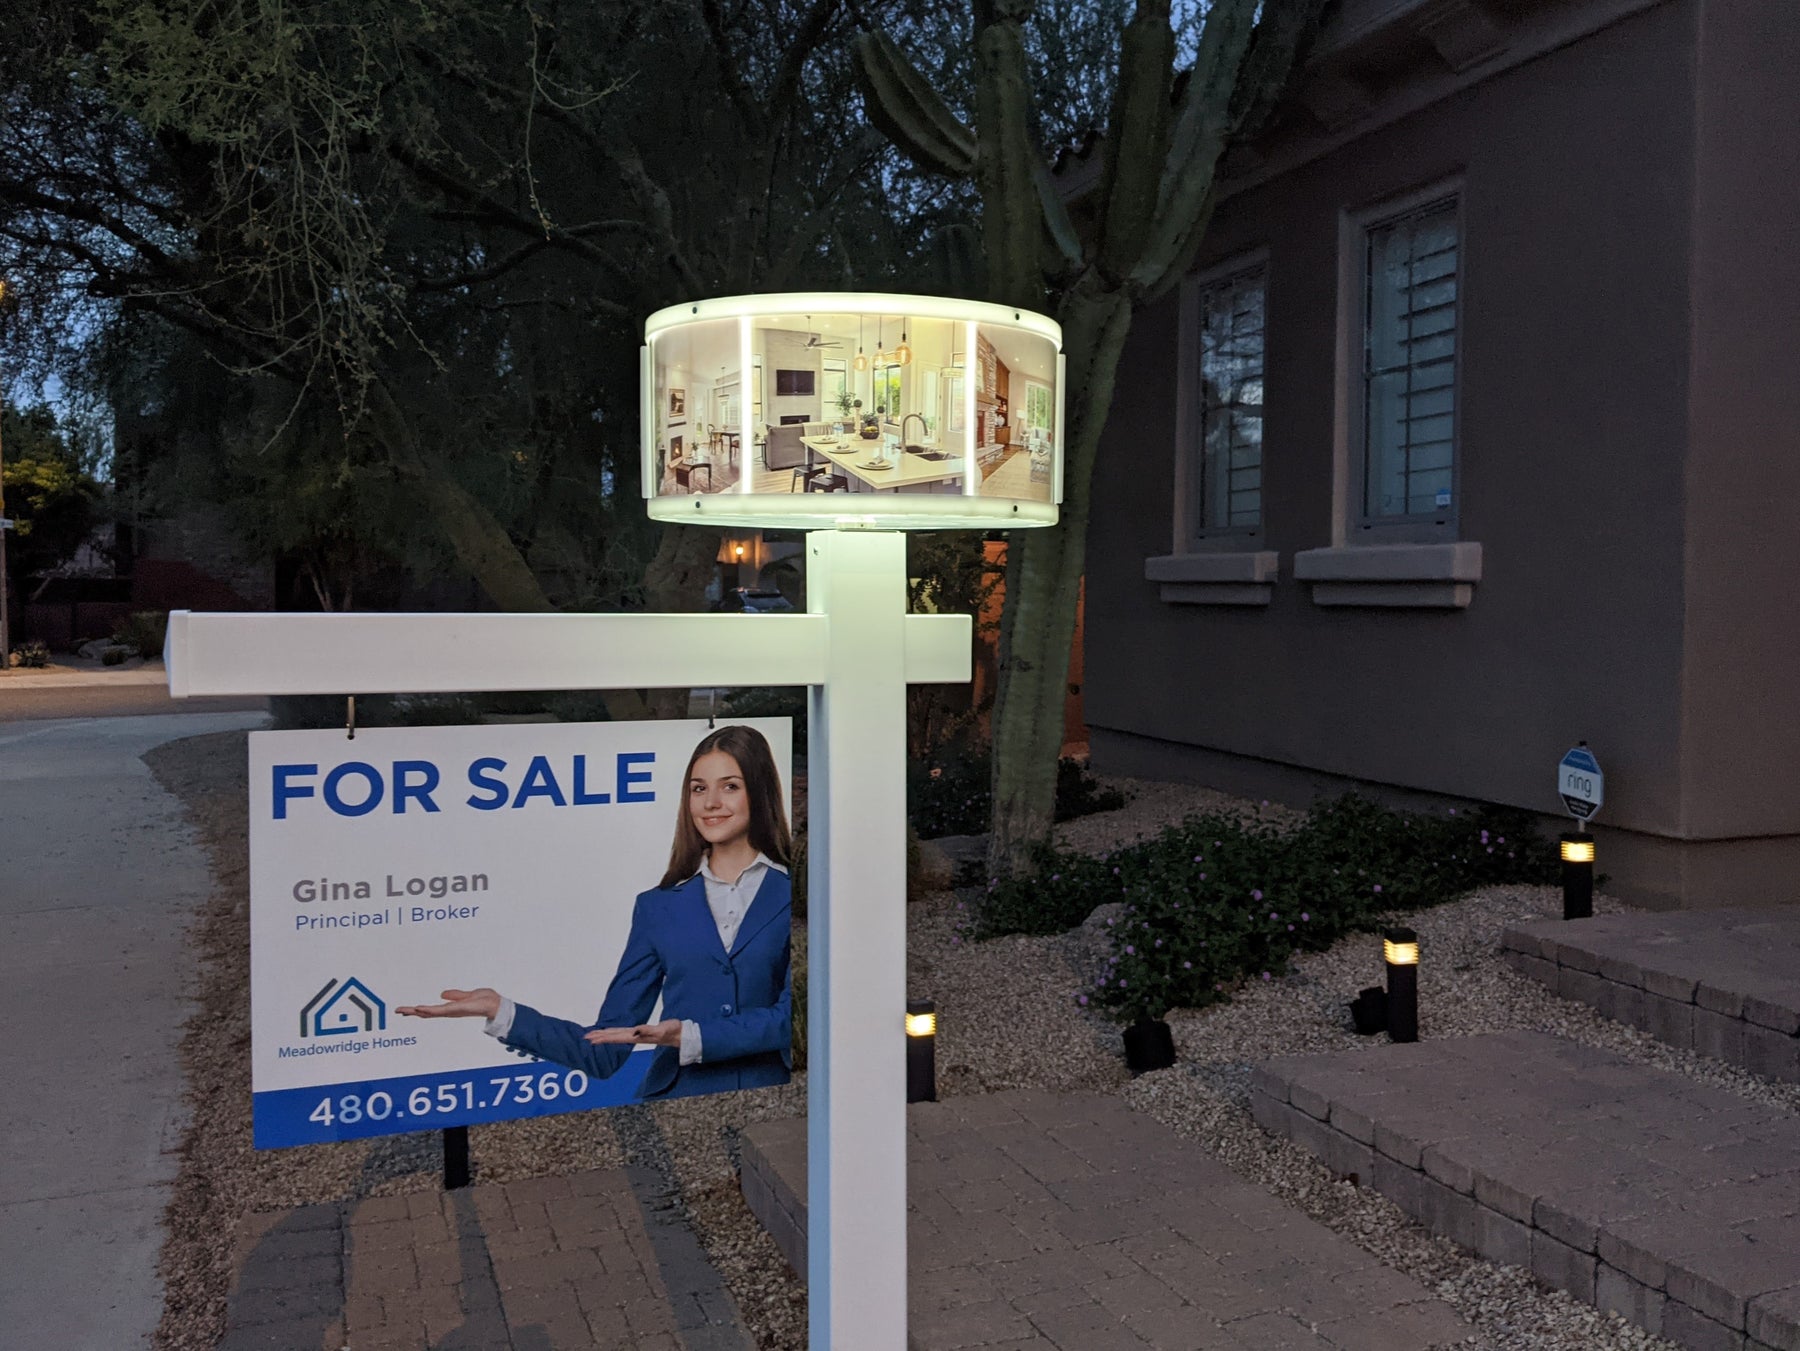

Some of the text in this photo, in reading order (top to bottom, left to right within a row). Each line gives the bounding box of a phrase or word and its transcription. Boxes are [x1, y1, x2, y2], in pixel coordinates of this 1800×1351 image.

[272, 752, 656, 819] FOR SALE
[1567, 772, 1592, 798] ring
[293, 873, 489, 902] Gina Logan
[296, 909, 389, 930] Principal
[411, 904, 480, 922] Broker
[278, 1035, 417, 1058] Meadowridge Homes
[308, 1069, 589, 1127] 480.651.7360
